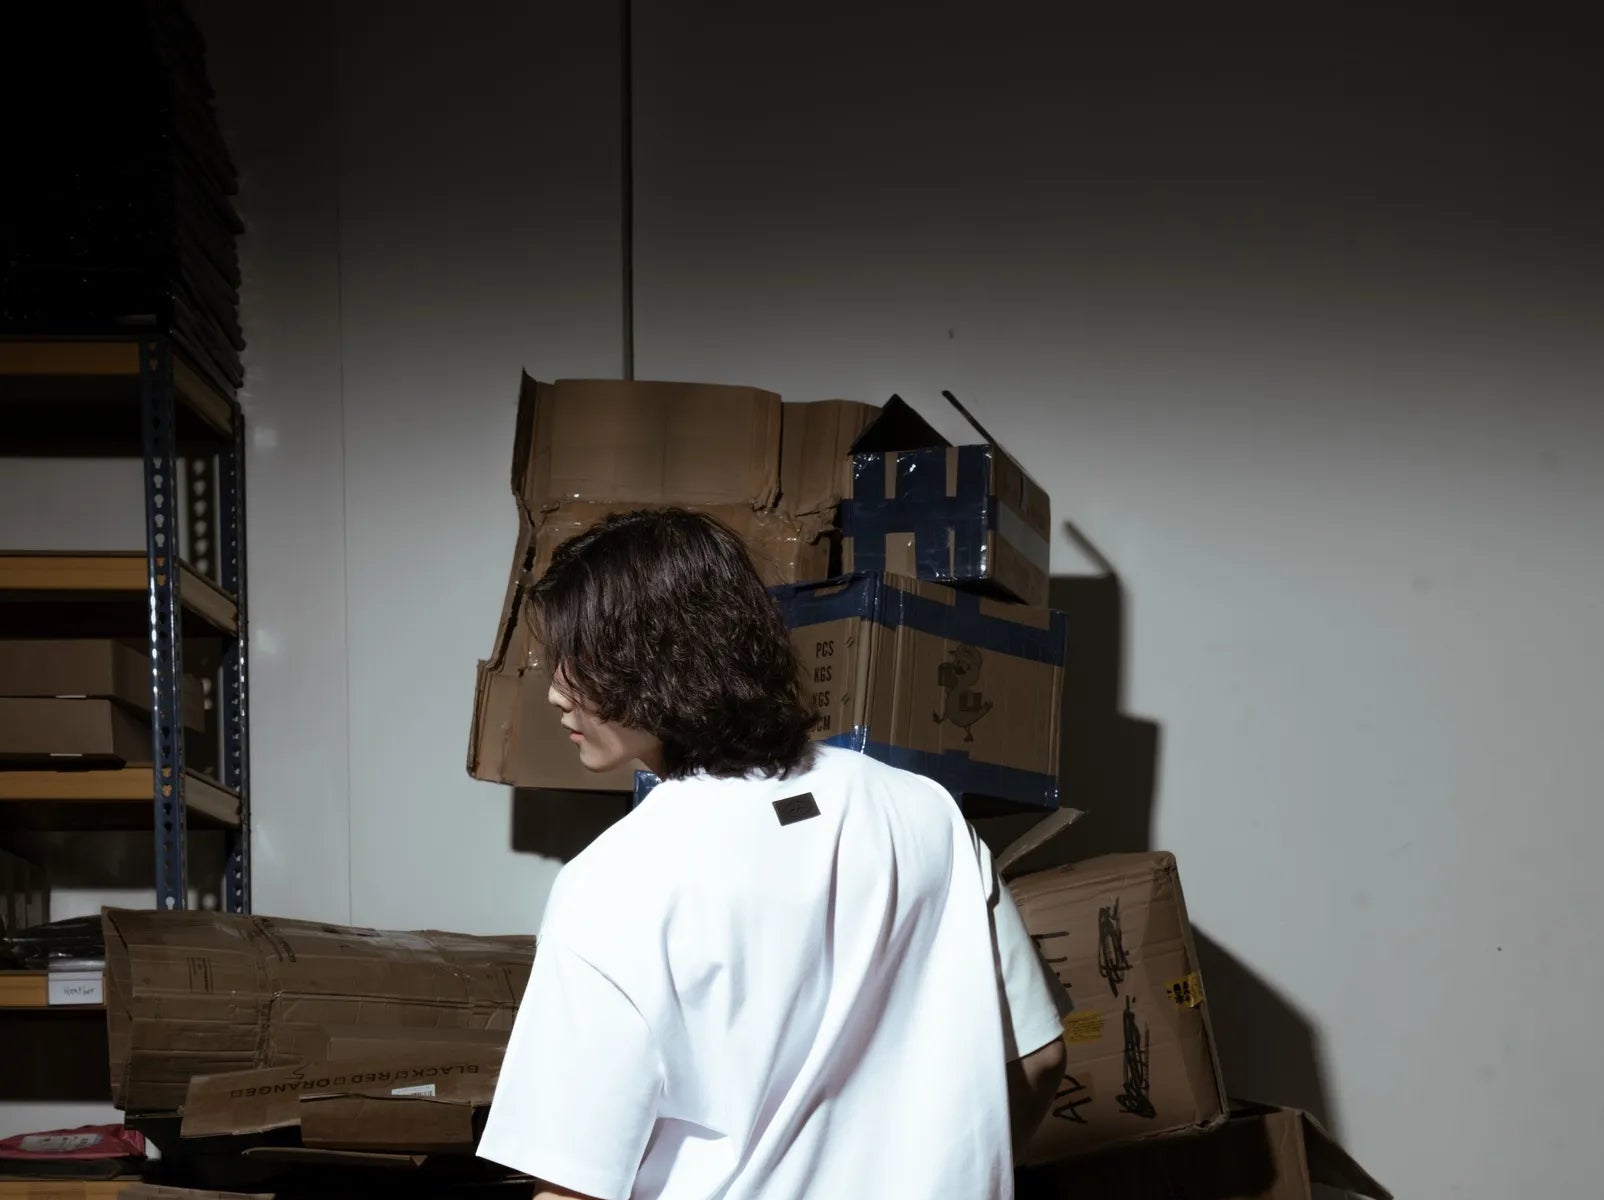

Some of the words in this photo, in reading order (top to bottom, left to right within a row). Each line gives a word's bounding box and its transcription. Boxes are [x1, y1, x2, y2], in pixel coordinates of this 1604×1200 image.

[815, 640, 834, 658] PCS
[814, 665, 832, 682] KGS
[351, 1071, 391, 1084] RED
[406, 1064, 479, 1077] BLACK
[245, 1078, 333, 1097] ORANGE
